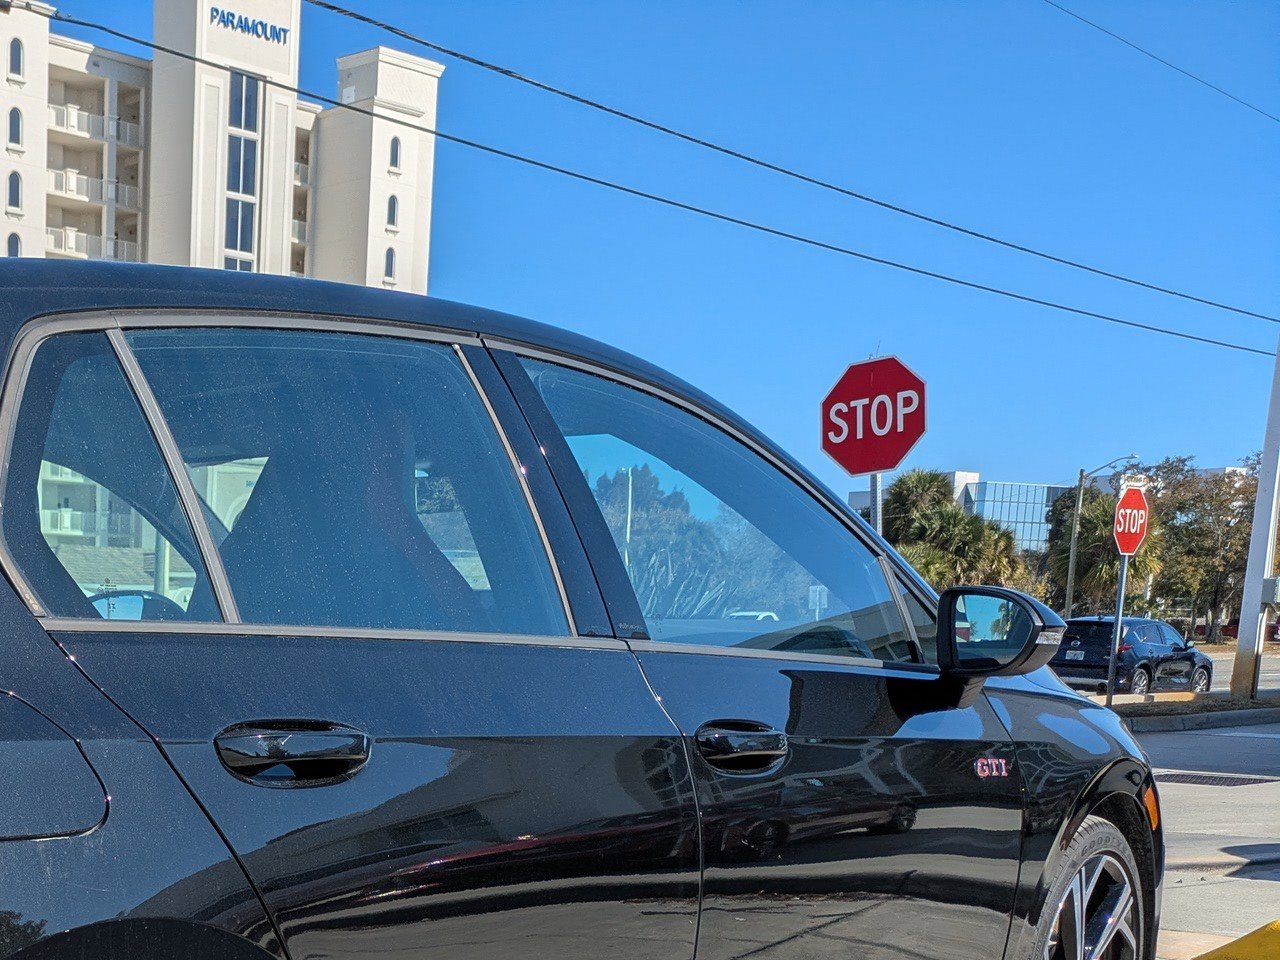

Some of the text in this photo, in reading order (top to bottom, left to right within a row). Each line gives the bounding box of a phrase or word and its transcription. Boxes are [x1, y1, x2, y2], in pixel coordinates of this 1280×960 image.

[210, 7, 290, 46] PARAMOUNT
[828, 389, 920, 444] STOP
[1116, 508, 1146, 534] STOP
[976, 757, 1009, 777] GTI
